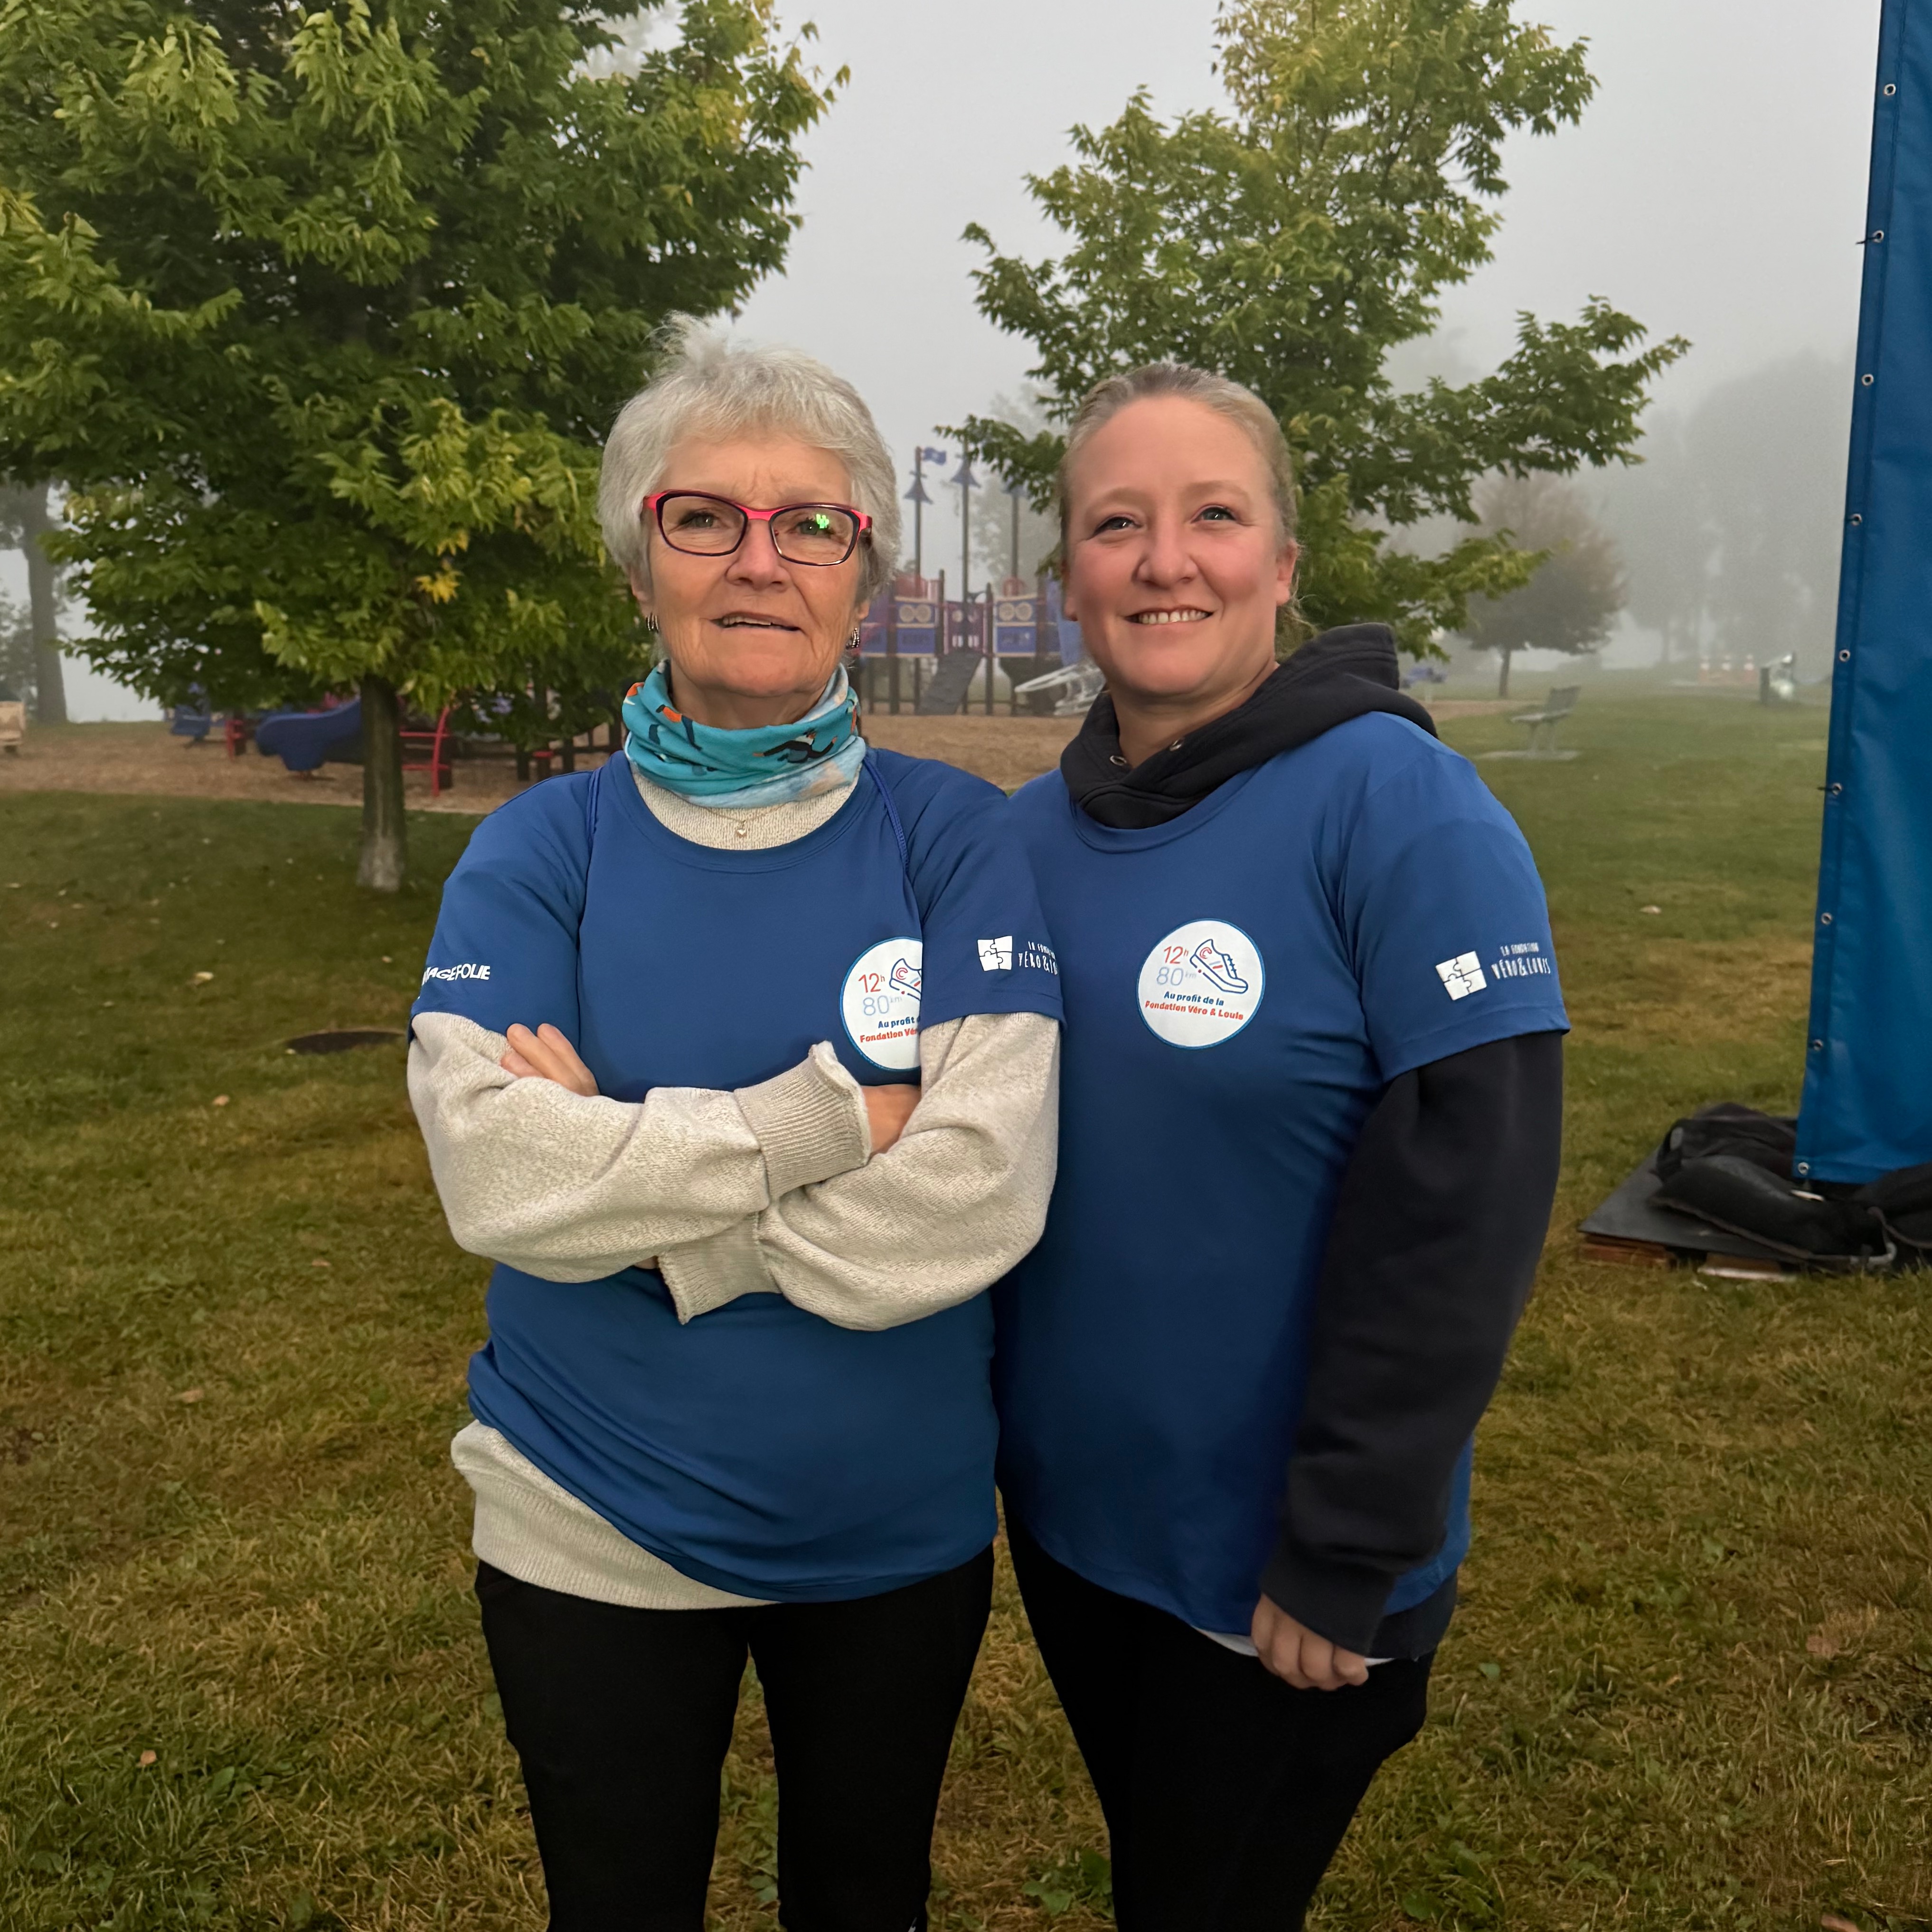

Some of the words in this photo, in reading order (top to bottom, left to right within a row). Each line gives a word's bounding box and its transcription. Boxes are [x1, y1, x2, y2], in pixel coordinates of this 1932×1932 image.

[1164, 991, 1175, 999] Au
[1177, 994, 1201, 1002] profit
[1203, 996, 1214, 1005] de
[1216, 998, 1224, 1006] la
[1145, 1000, 1186, 1012] Fondation
[1188, 1005, 1208, 1015] Véro
[1218, 1010, 1244, 1020] Louis
[878, 1020, 889, 1028] Au
[891, 1016, 915, 1028] profit
[860, 1031, 903, 1043] Fondation
